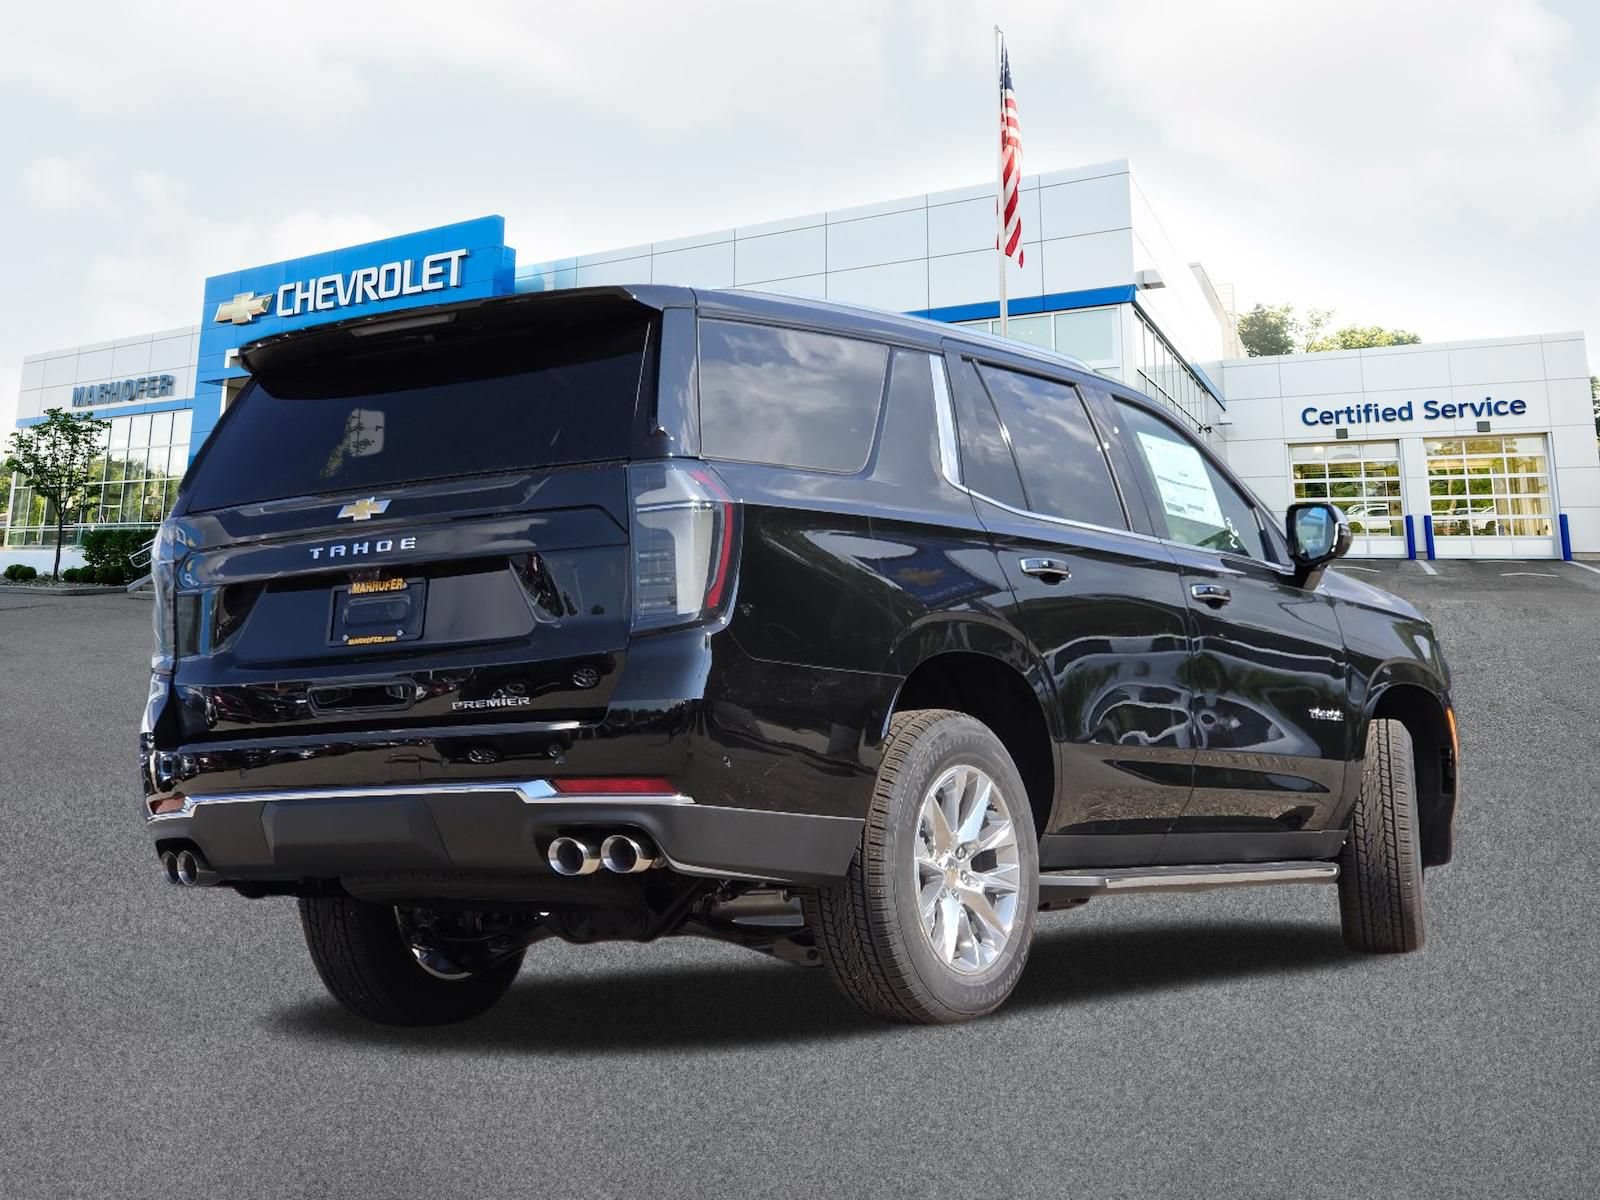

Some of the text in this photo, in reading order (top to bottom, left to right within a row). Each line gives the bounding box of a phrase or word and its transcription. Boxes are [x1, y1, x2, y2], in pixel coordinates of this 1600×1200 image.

[277, 249, 468, 317] CHEVROLET
[72, 375, 175, 407] MARHOFER
[1301, 397, 1527, 426] Certified Service
[309, 537, 416, 559] TAHOE
[351, 578, 404, 594] MARHOFER
[452, 695, 530, 710] PREMIER
